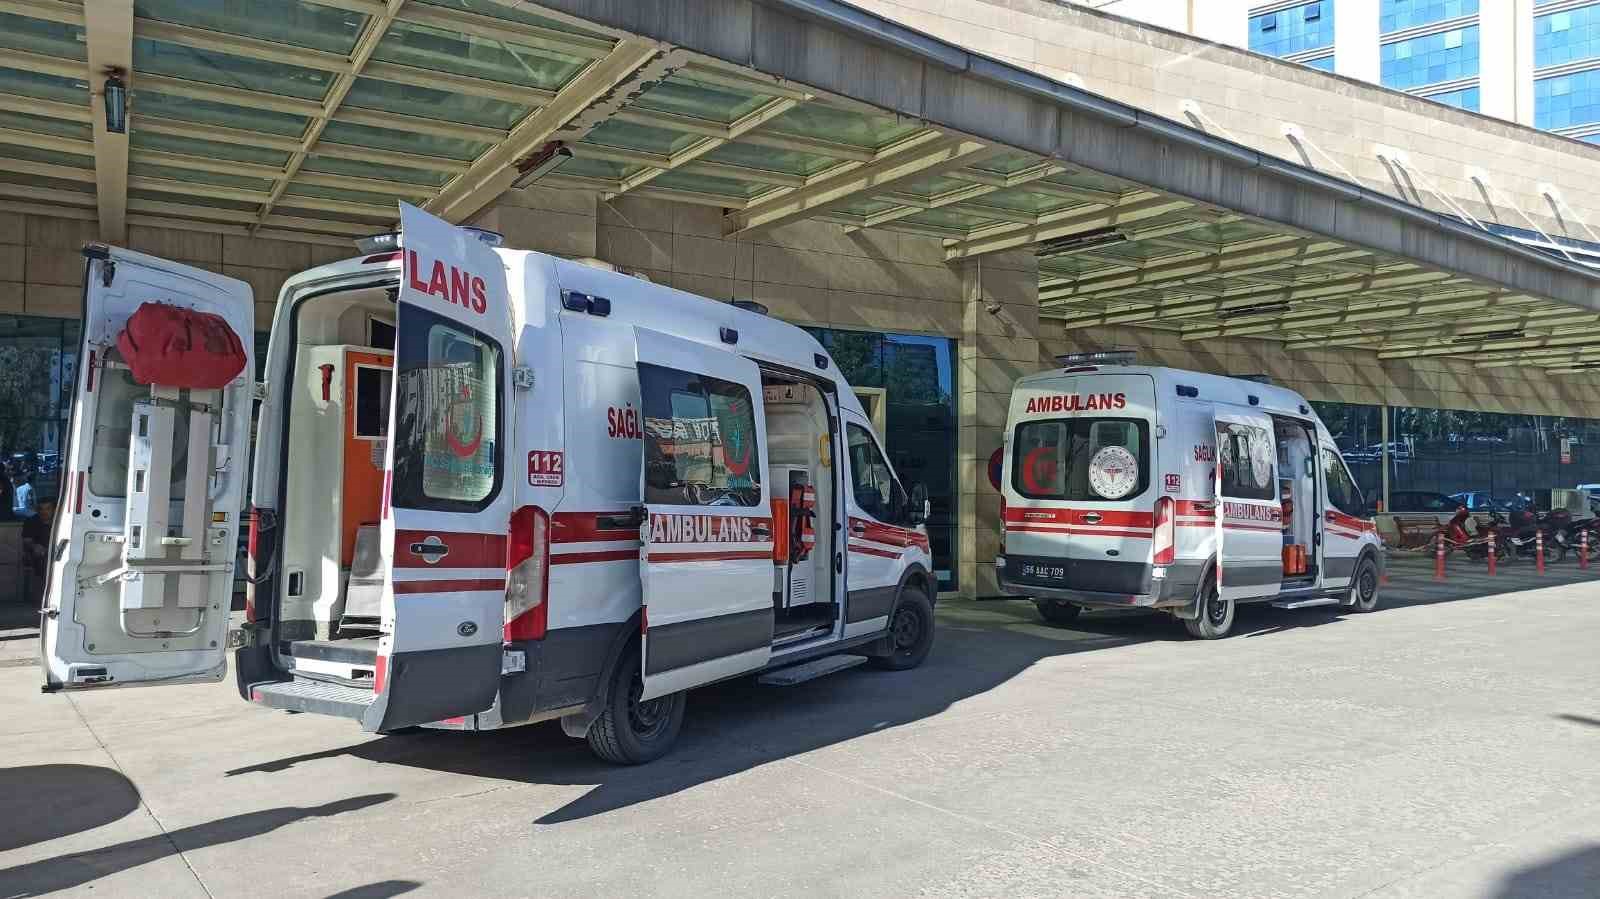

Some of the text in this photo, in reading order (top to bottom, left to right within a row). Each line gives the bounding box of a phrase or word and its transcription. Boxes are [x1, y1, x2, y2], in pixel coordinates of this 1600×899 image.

[410, 249, 487, 314] LANS
[1026, 392, 1126, 413] AMBULANS
[530, 453, 562, 472] 112
[1223, 501, 1272, 521] AMBULANS
[650, 514, 752, 543] AMBULANS
[1050, 567, 1064, 577] 709
